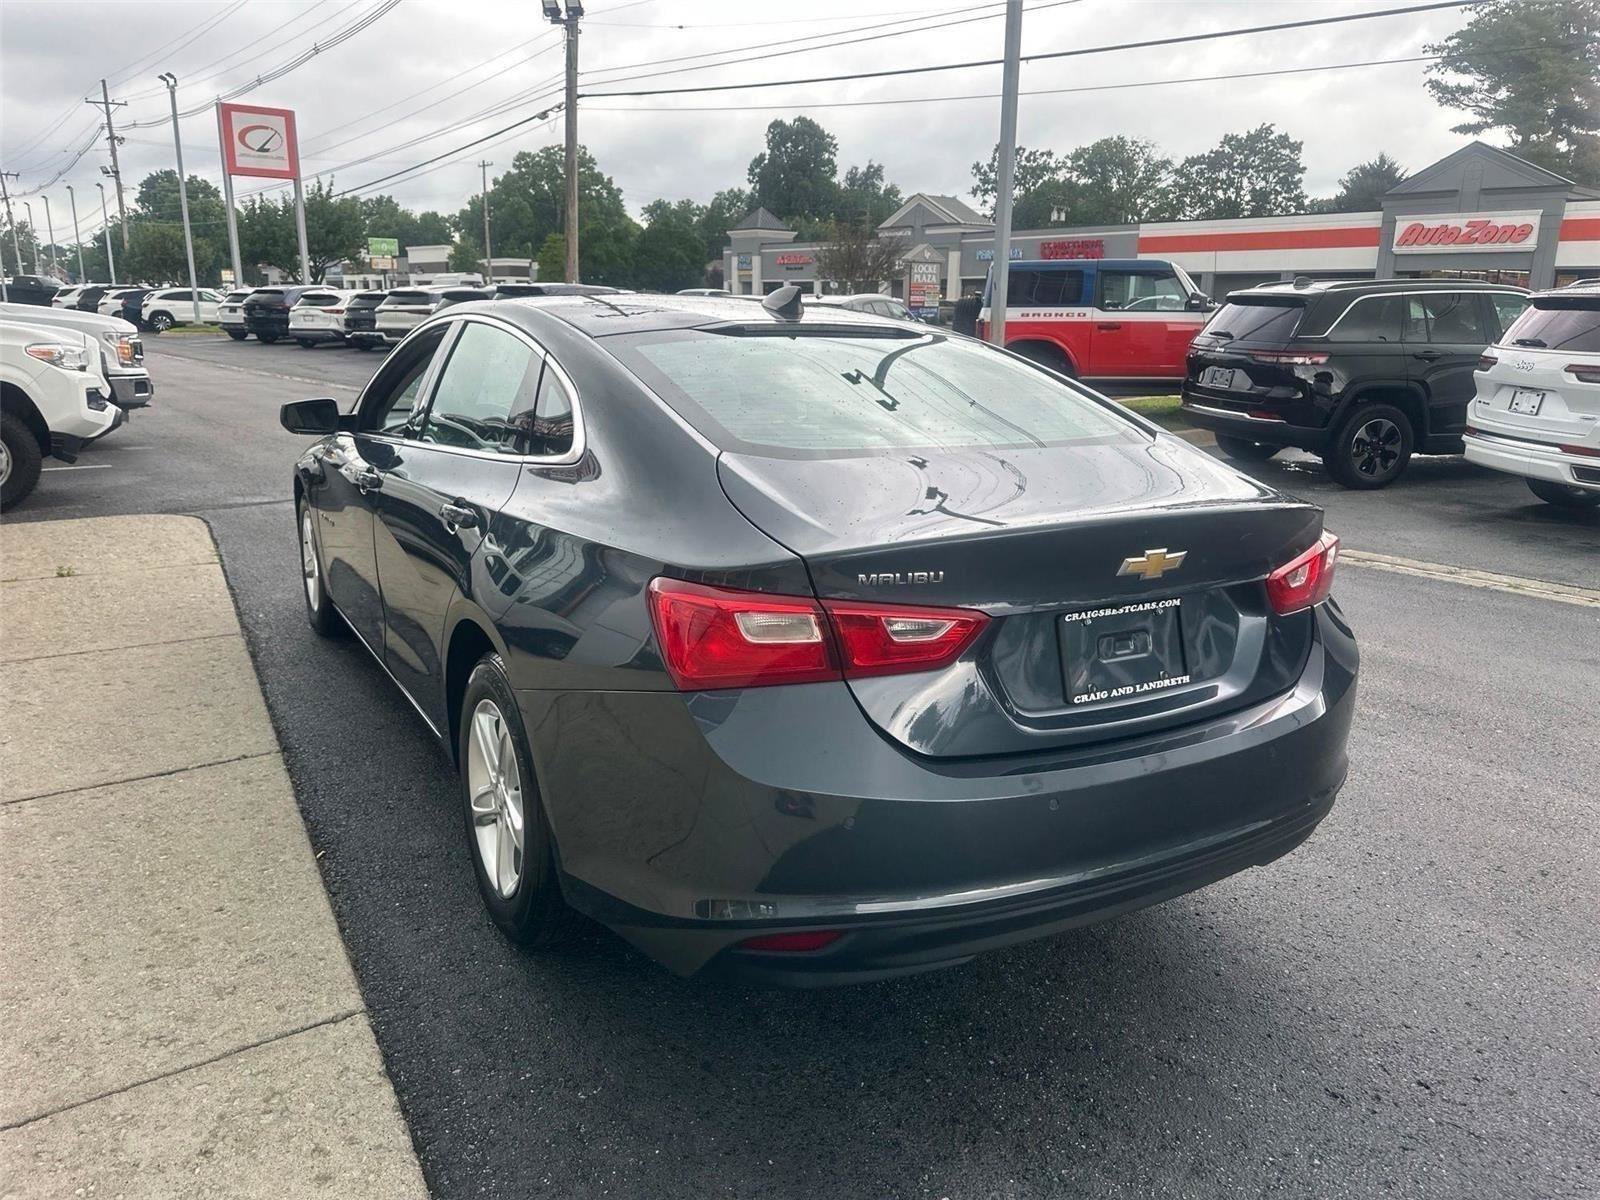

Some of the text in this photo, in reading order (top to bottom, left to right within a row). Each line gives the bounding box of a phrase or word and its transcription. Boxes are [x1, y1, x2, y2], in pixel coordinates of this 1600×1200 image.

[1395, 220, 1533, 246] AutoZone
[914, 264, 937, 274] LOCKE
[913, 274, 937, 283] PLAZA
[1515, 360, 1535, 372] Jeep
[858, 571, 944, 585] MALIBU
[1064, 598, 1181, 622] CRAIGSBESTCARS.COM
[1073, 675, 1190, 704] CRAIG AND LANDRETH
